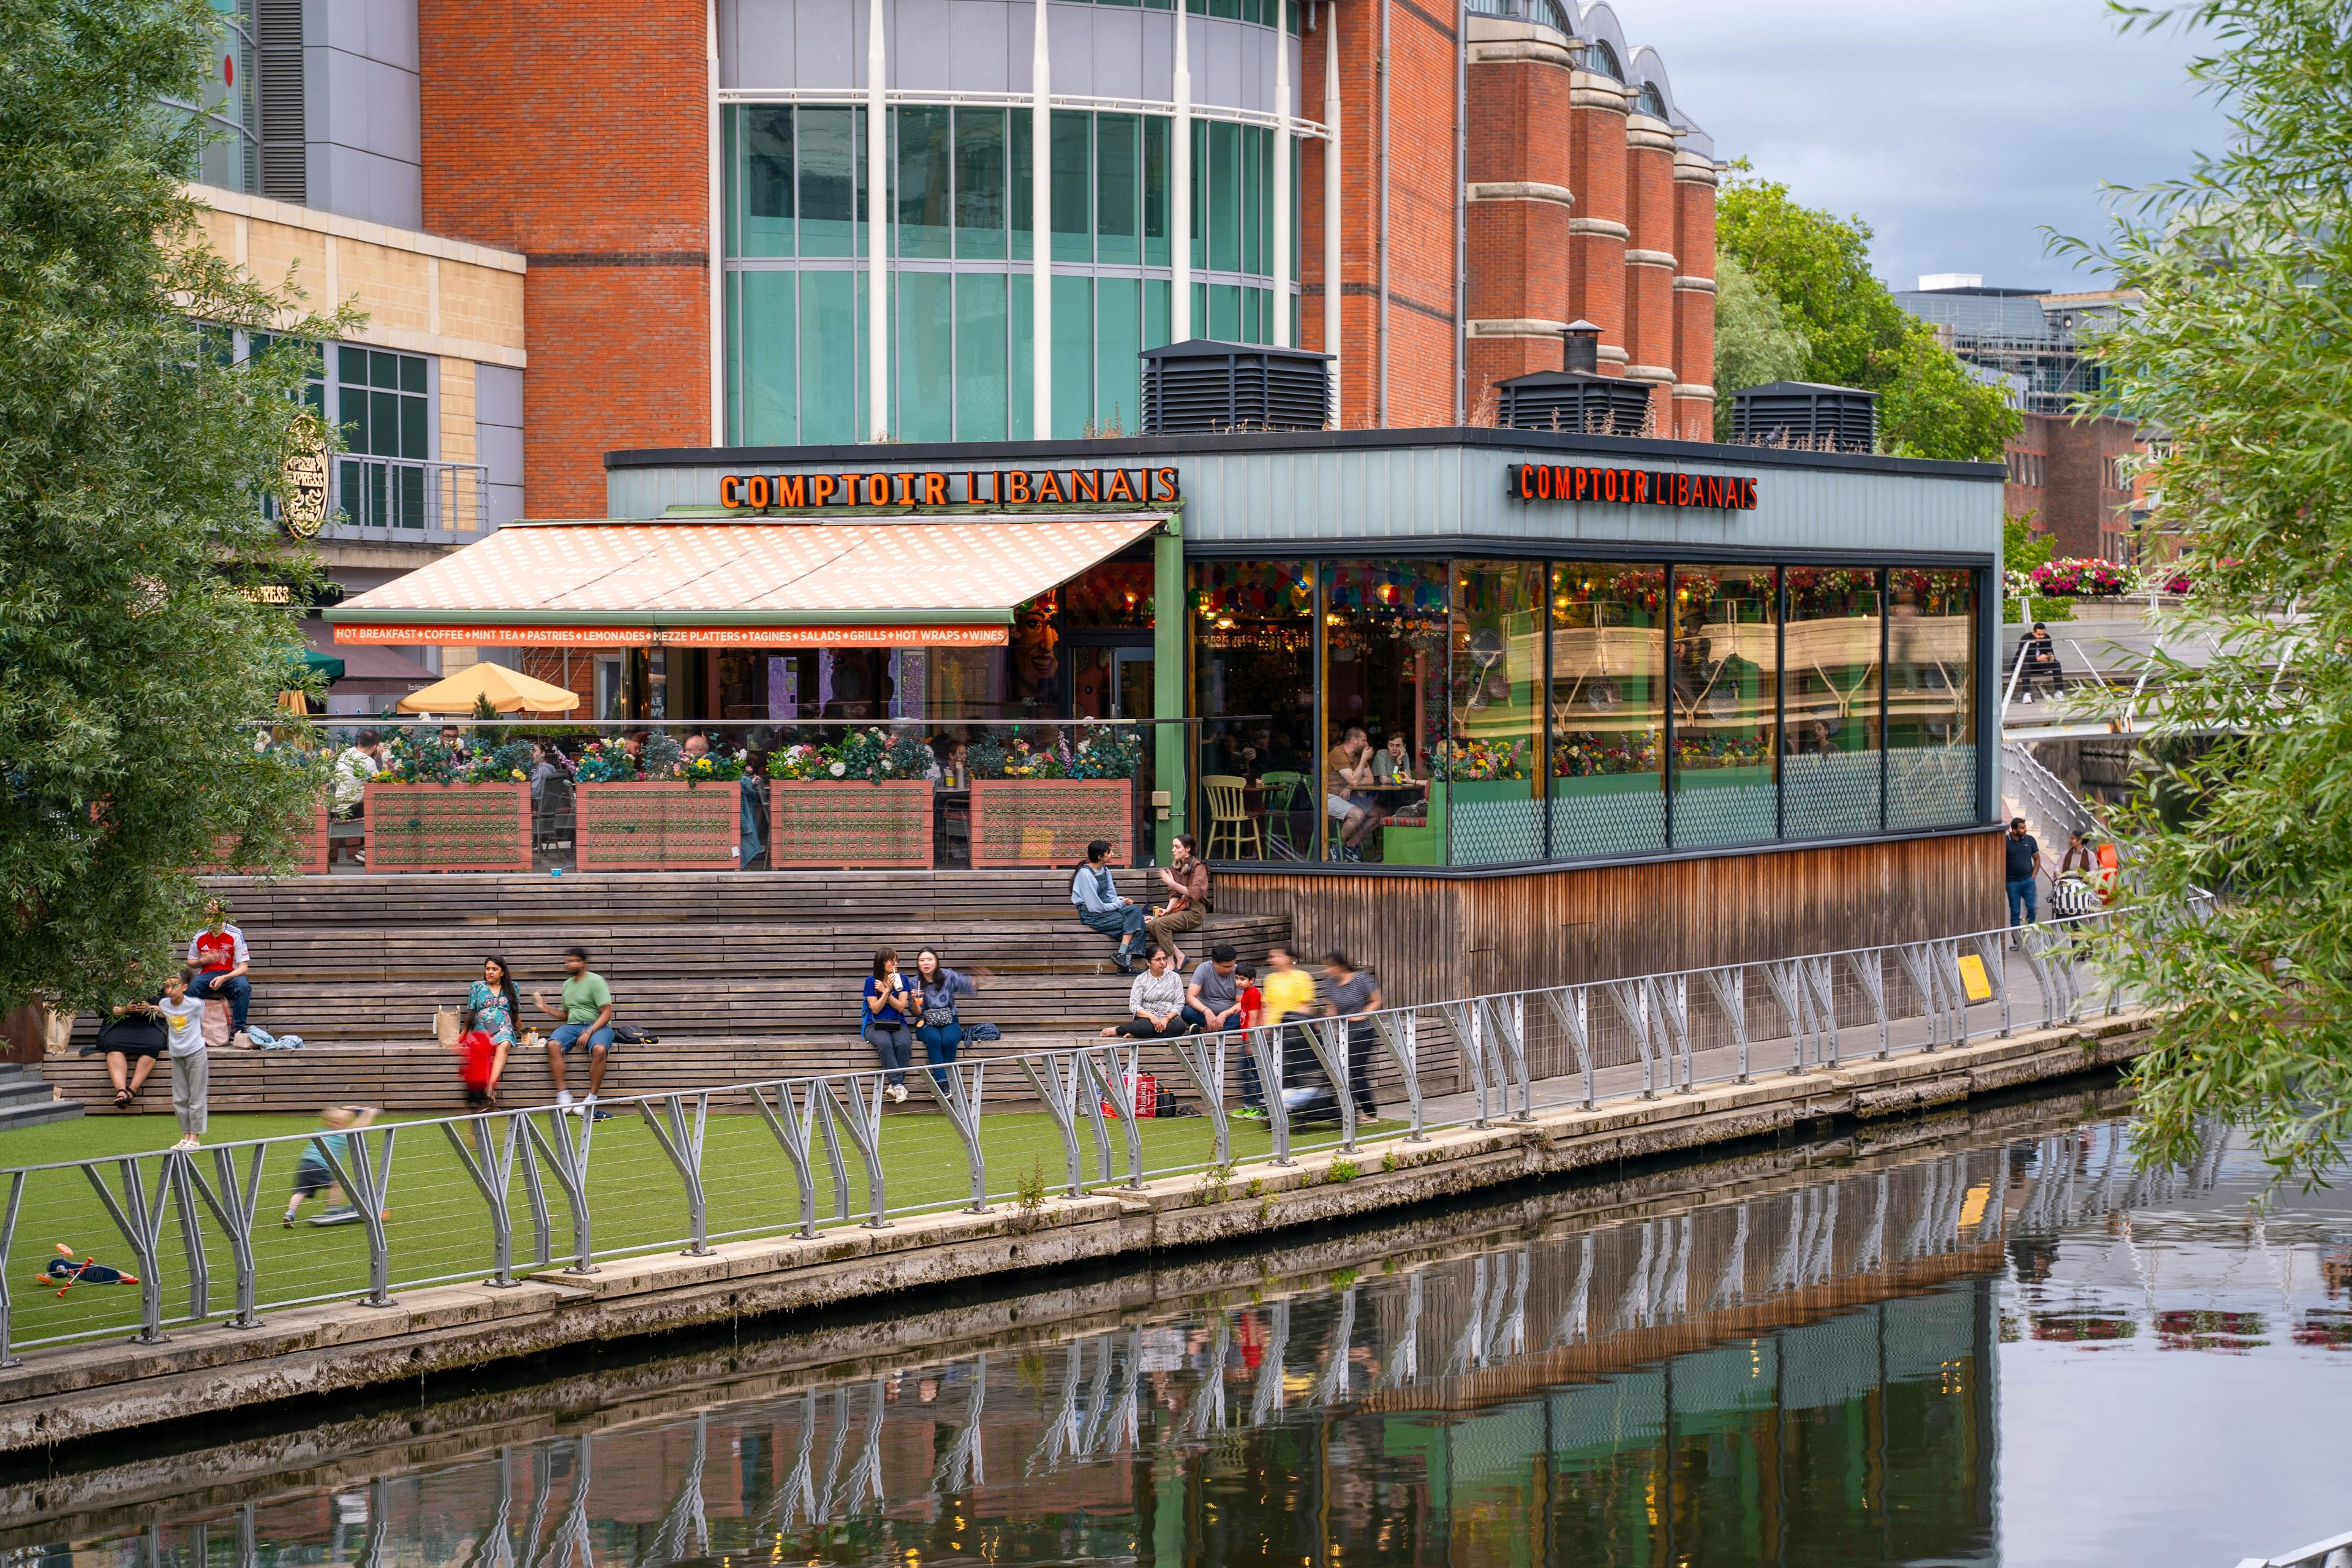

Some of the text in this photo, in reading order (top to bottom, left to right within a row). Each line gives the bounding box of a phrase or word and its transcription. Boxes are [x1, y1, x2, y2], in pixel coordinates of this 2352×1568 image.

[721, 467, 1177, 508] COMPTOIR LIBANAIS
[1521, 464, 1757, 510] COMPTOIR LIBANAIS
[336, 628, 1005, 641] HOT BREAKFAST COFFEE MINT TEA PASTRIES LEMONADES MEZZE PLATTERS TAGINES SALADS GRILLS HOT WRAPS WINES
